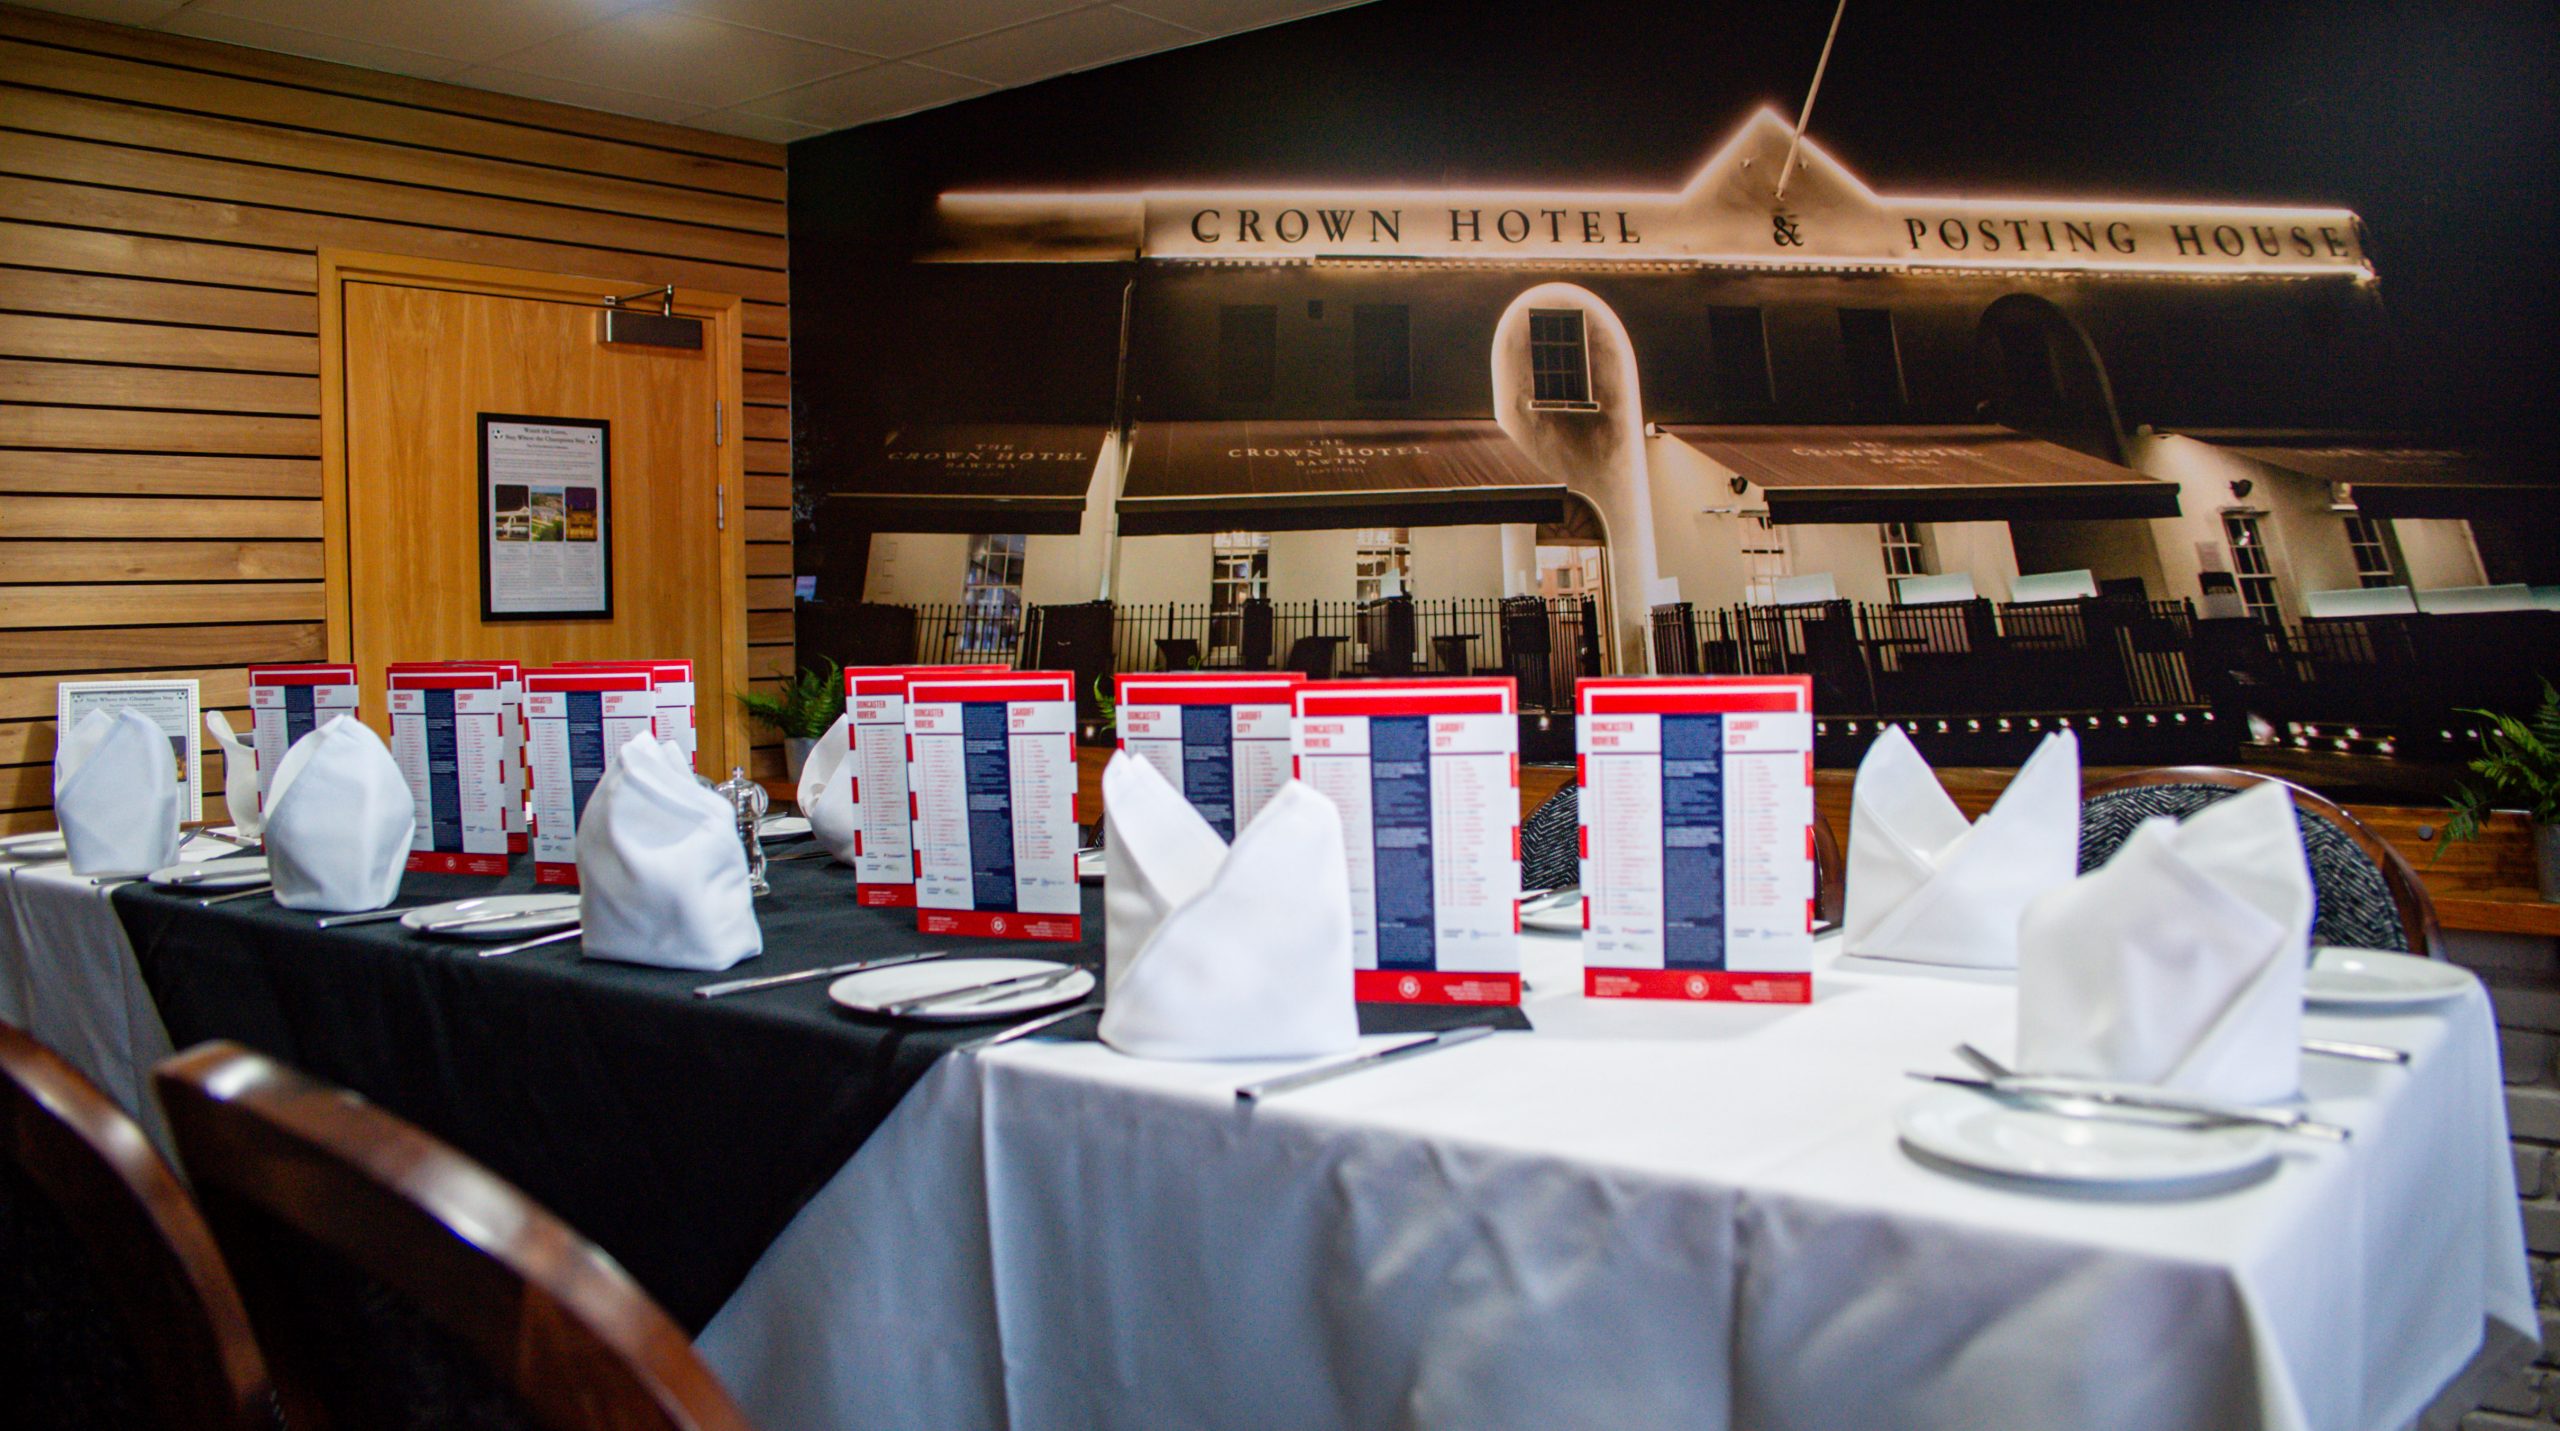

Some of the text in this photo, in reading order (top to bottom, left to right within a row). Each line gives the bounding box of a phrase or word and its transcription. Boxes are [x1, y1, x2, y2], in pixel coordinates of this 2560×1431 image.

[1190, 208, 2351, 257] CROWN HOTEL & POSTING HOUSE
[887, 451, 1088, 461] CROWN HOTEL
[1228, 446, 1429, 458] CROWN HOTEL
[1012, 719, 1025, 728] CITY
[1237, 723, 1251, 733] CITY
